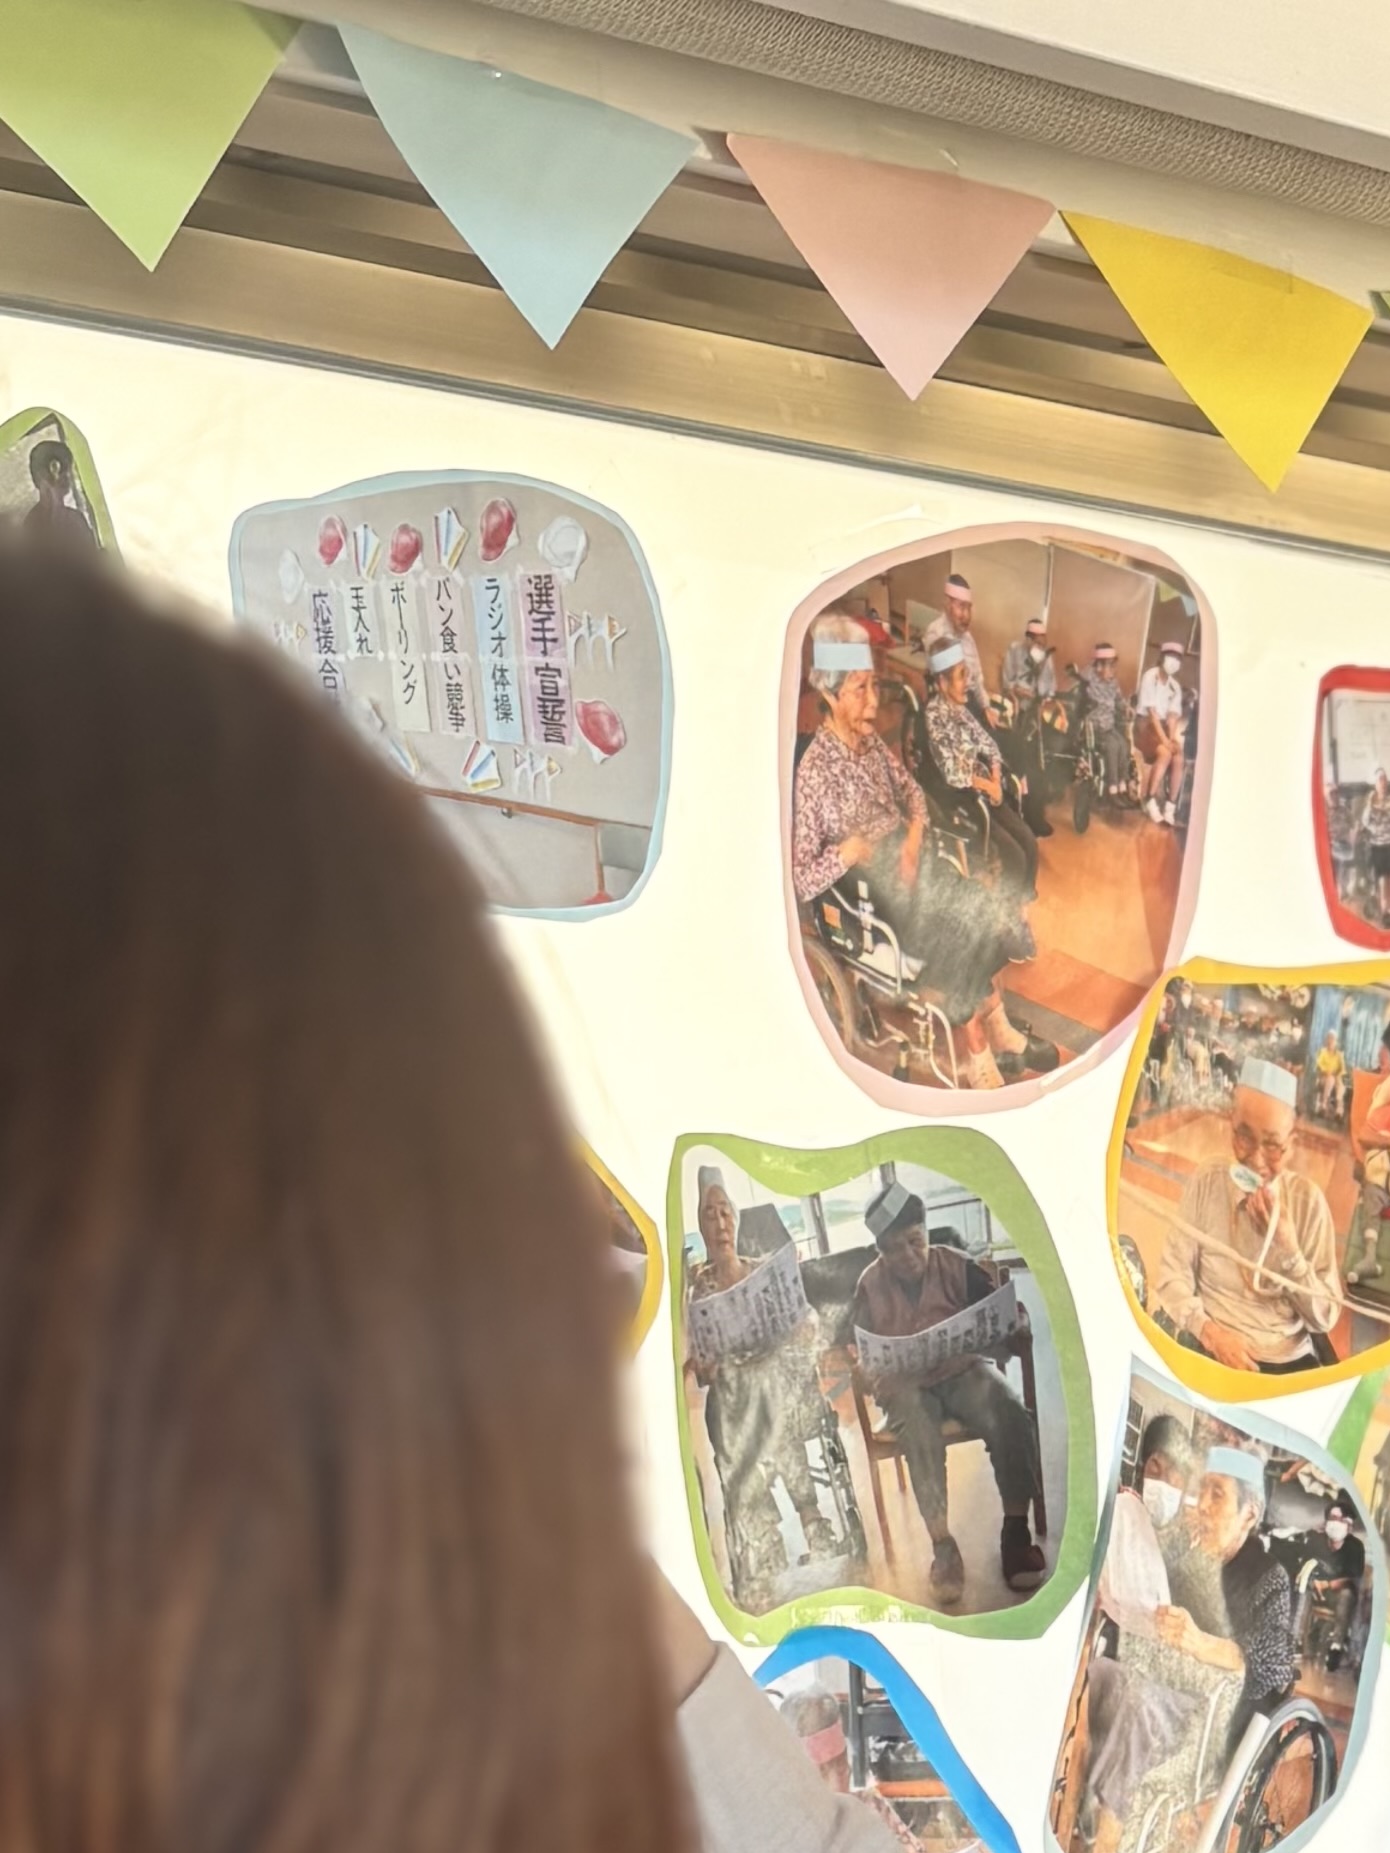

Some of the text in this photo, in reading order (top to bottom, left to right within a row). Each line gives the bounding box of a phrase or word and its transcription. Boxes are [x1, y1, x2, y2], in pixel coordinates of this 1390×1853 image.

[312, 589, 340, 700] 応援合
[350, 586, 373, 655] 玉入れ
[390, 582, 418, 705] ボーリング
[436, 577, 466, 733] パン食い競争
[485, 578, 514, 724] ラジオ体操
[526, 574, 567, 745] 選手宣誓
